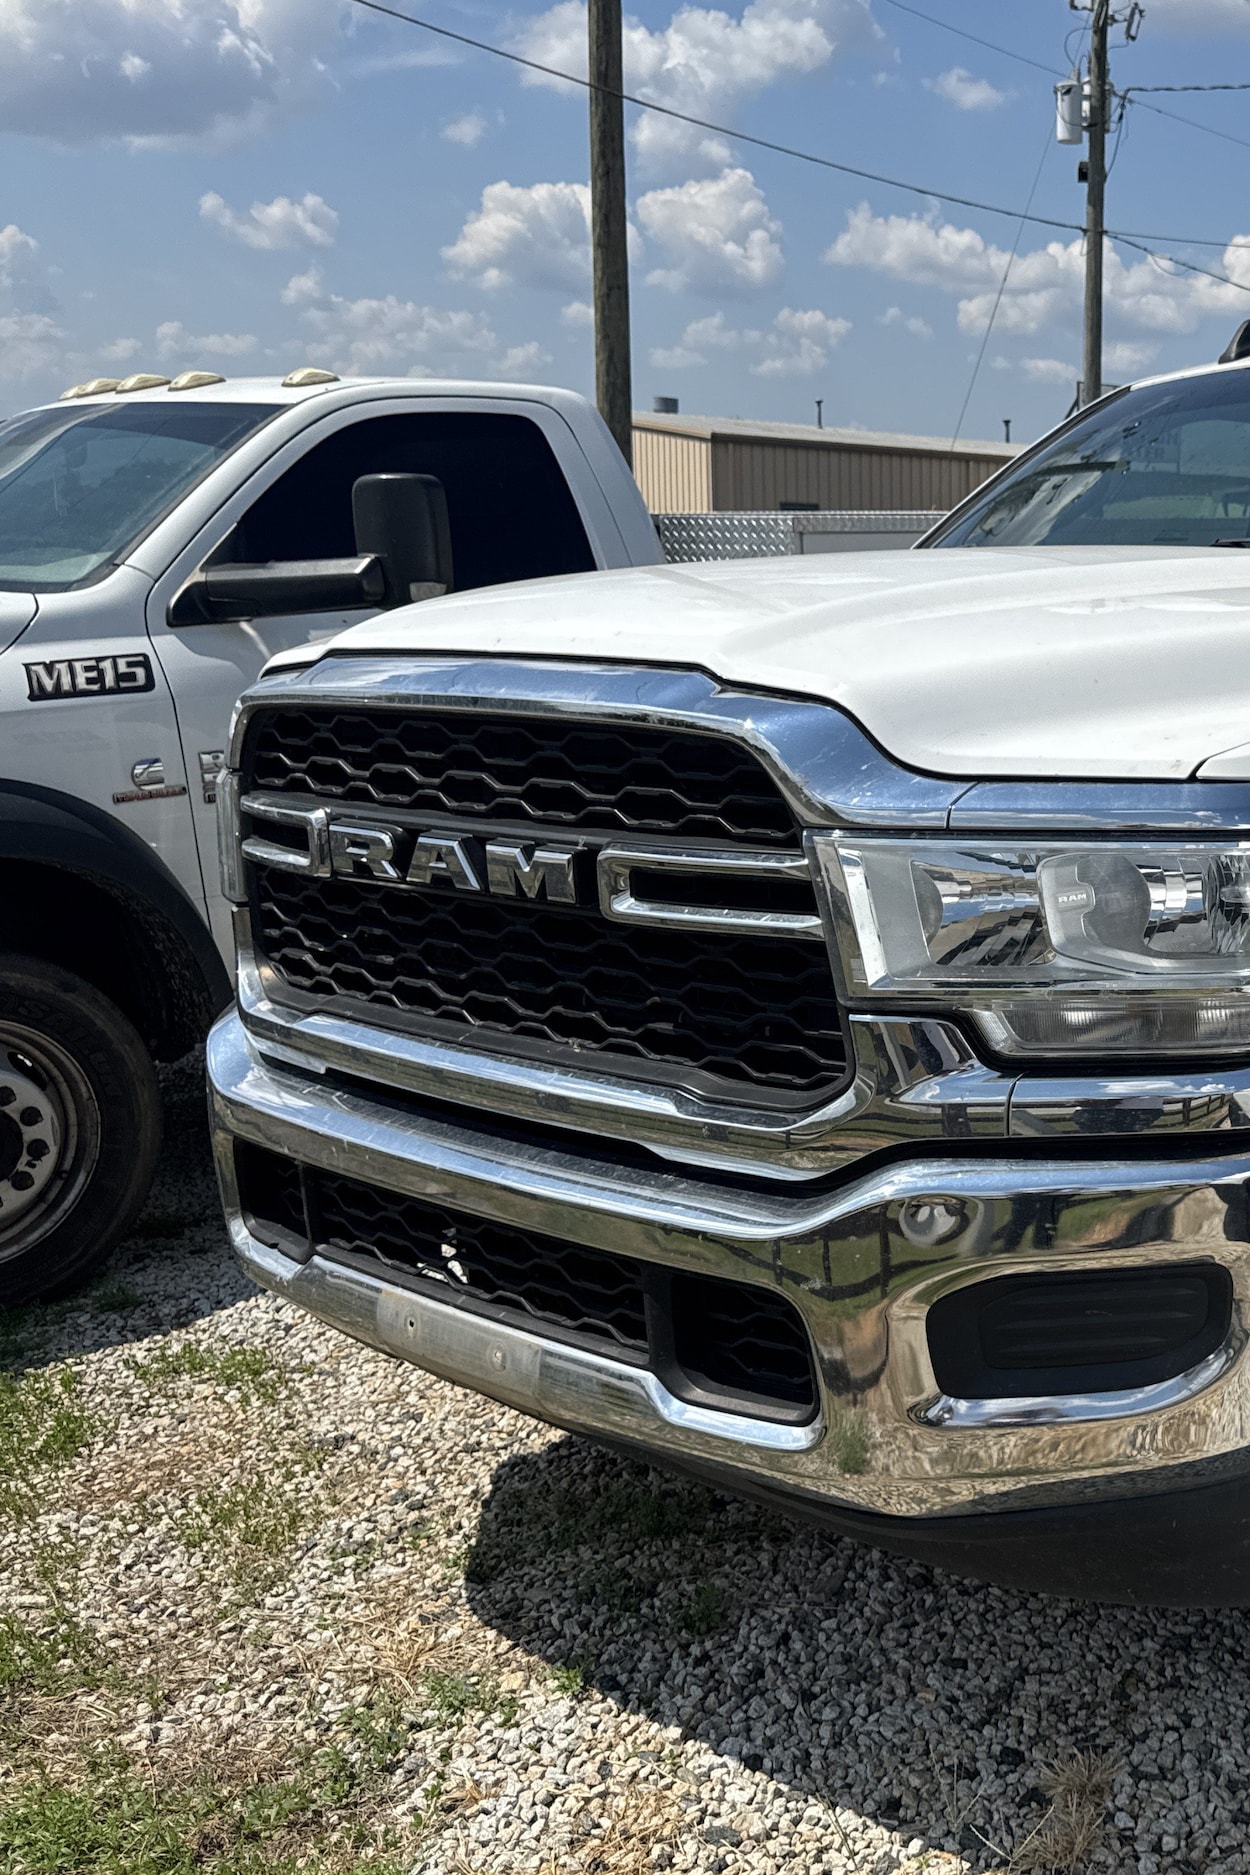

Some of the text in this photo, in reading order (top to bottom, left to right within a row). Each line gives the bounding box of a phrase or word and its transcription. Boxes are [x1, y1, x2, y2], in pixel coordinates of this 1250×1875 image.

[27, 655, 150, 698] ME15
[329, 819, 582, 904] RAM
[1058, 893, 1087, 903] RAM
